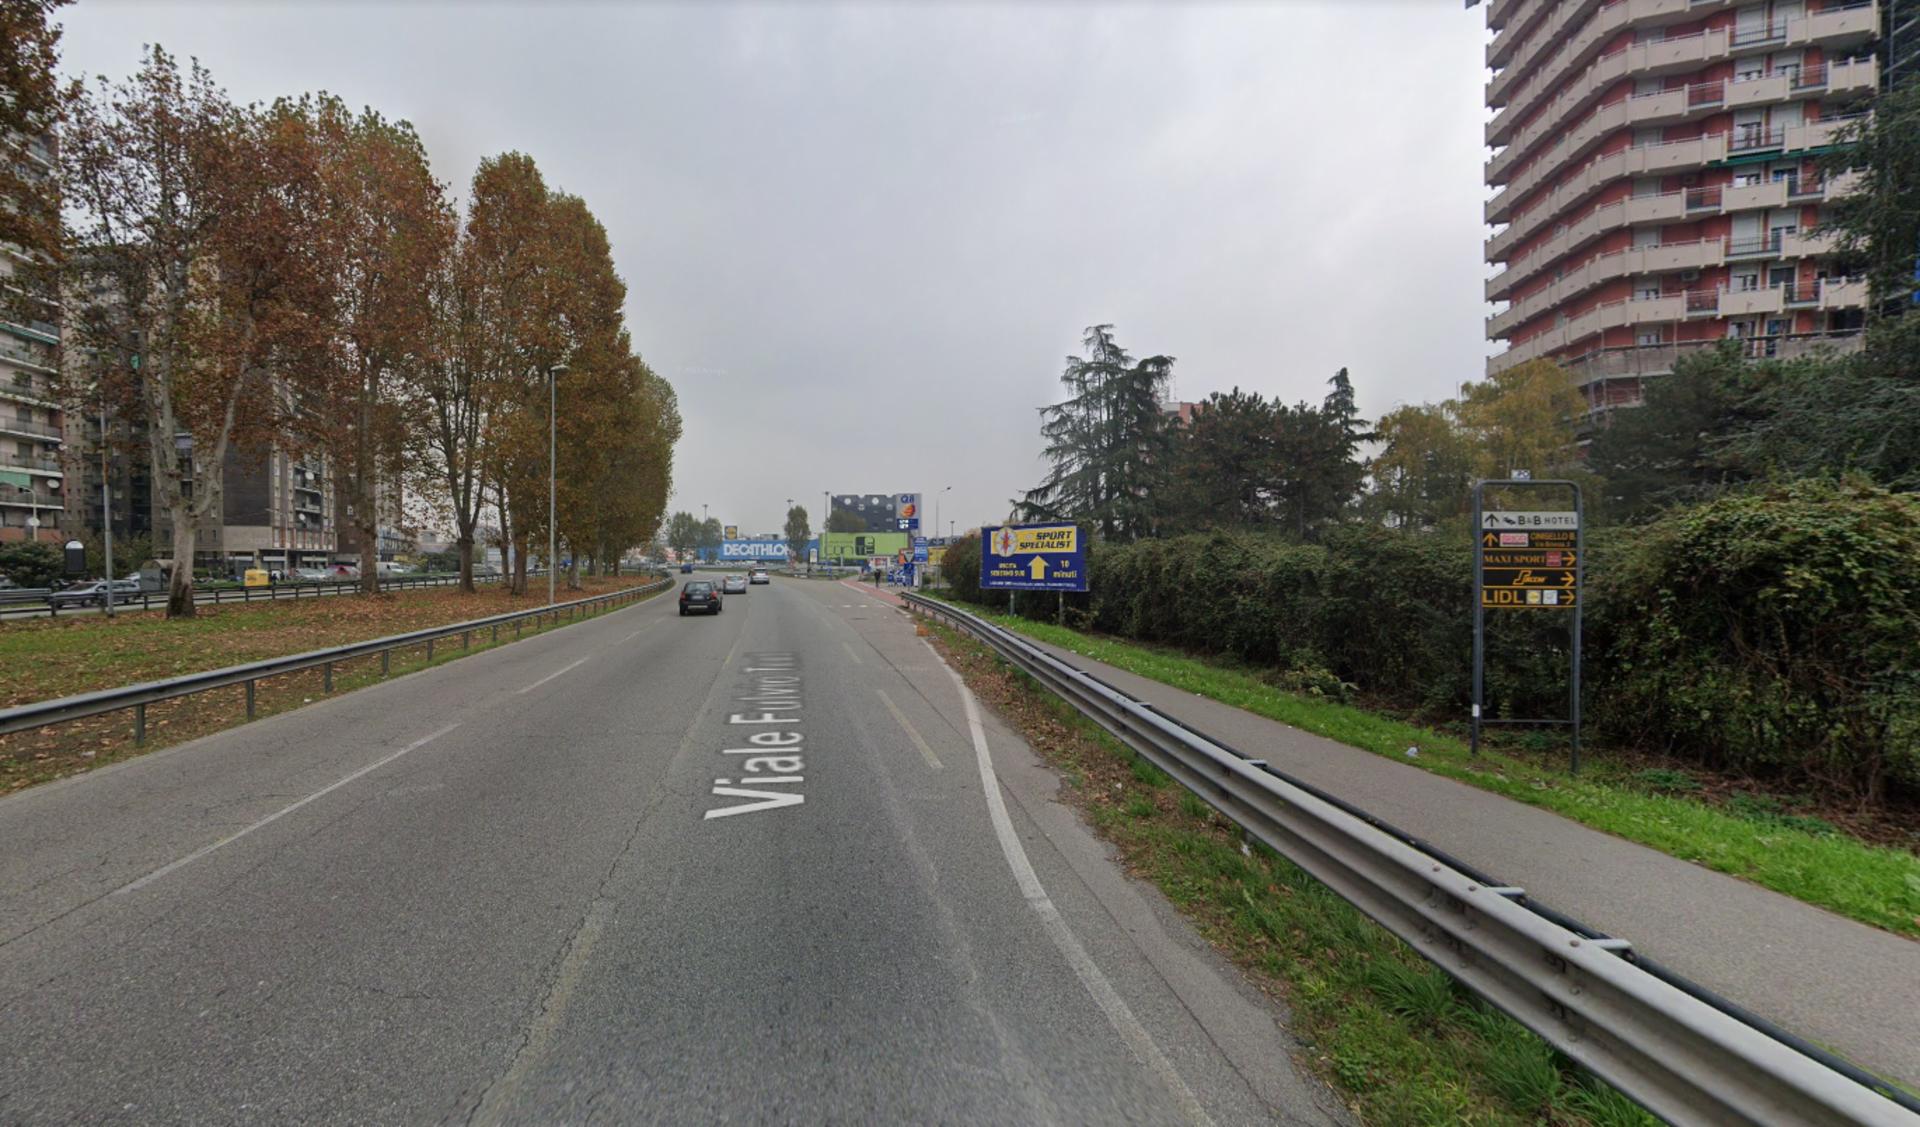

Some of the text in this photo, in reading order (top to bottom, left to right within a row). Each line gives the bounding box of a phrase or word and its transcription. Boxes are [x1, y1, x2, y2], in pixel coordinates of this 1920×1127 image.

[1544, 516, 1576, 525] HOTEL
[1035, 531, 1073, 541] SPORT
[1019, 541, 1072, 550] SPECIALIST
[1484, 555, 1512, 563] MAXI
[1514, 555, 1546, 563] SPORT
[1060, 560, 1070, 568] 10
[1053, 570, 1078, 578] minuti
[1482, 590, 1524, 604] LIDL
